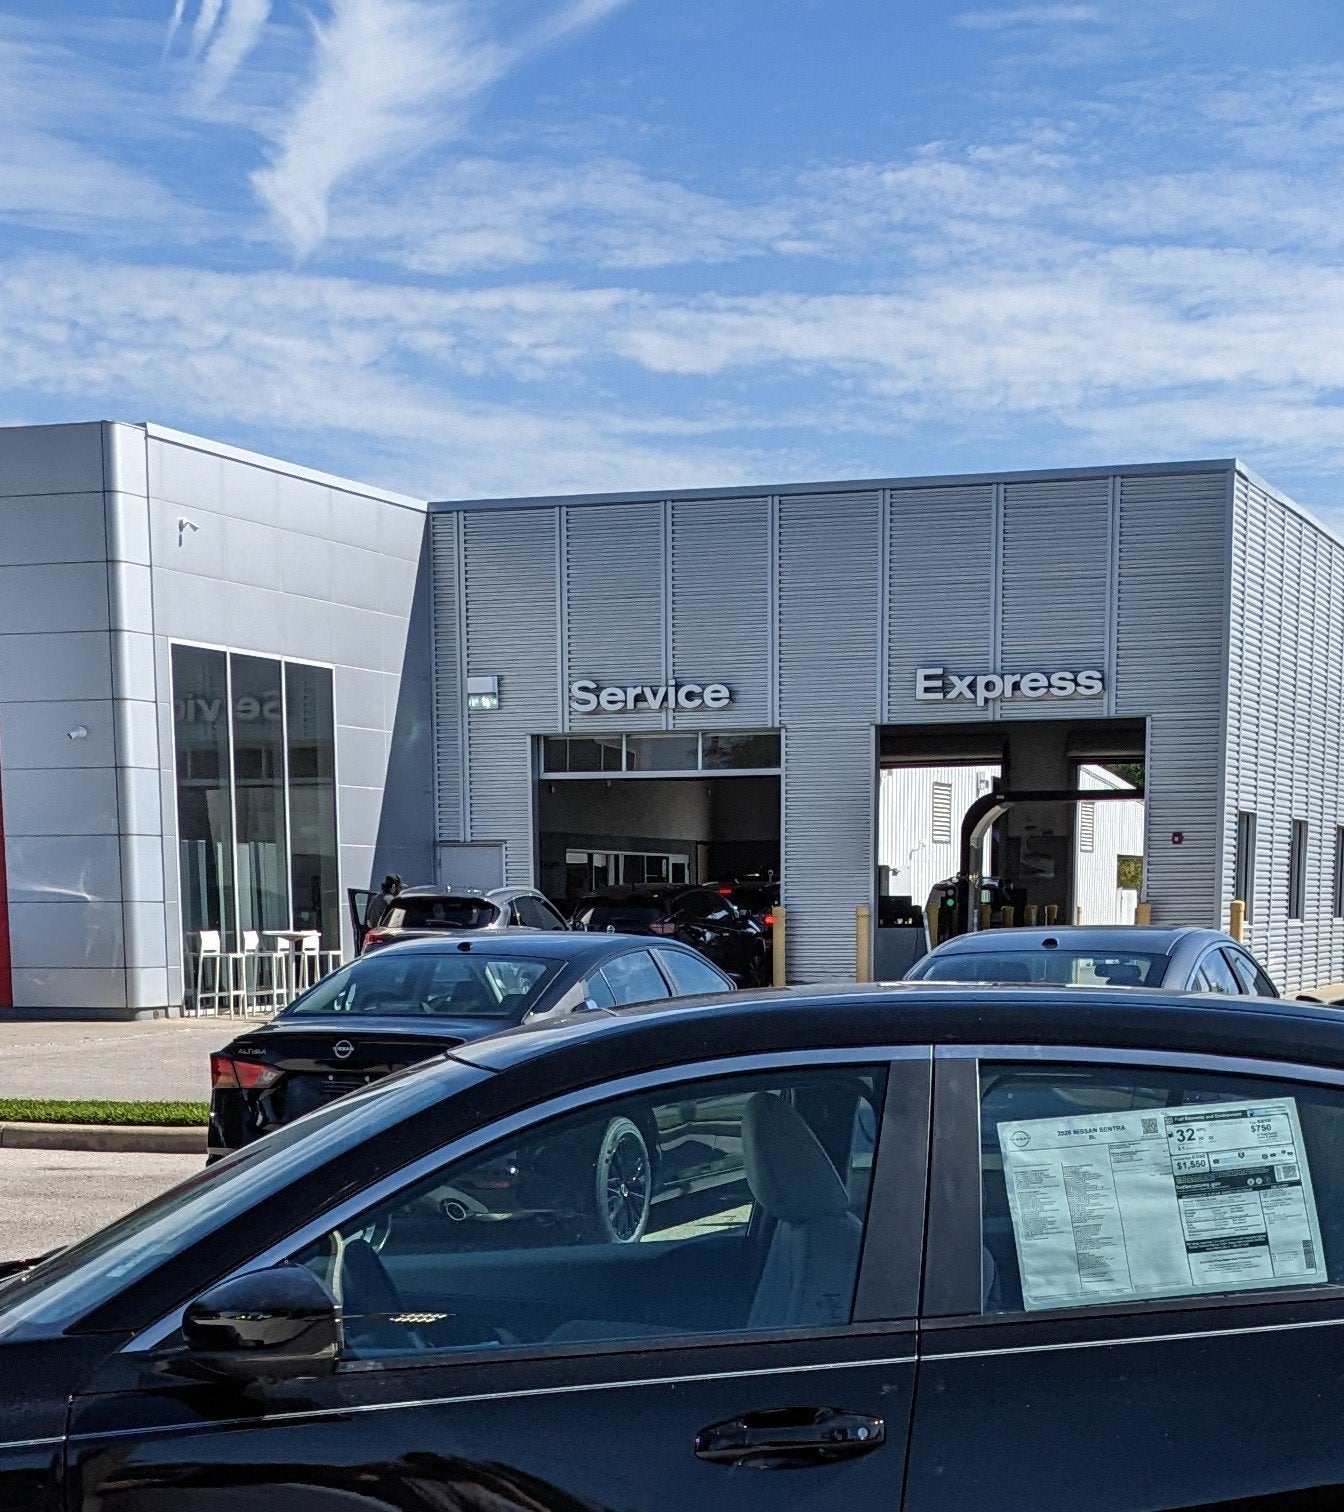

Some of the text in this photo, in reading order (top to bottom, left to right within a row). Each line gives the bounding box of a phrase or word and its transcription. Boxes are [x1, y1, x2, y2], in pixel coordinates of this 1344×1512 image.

[569, 678, 731, 712] Service
[914, 667, 1104, 706] Express
[1176, 1128, 1196, 1142] 32
